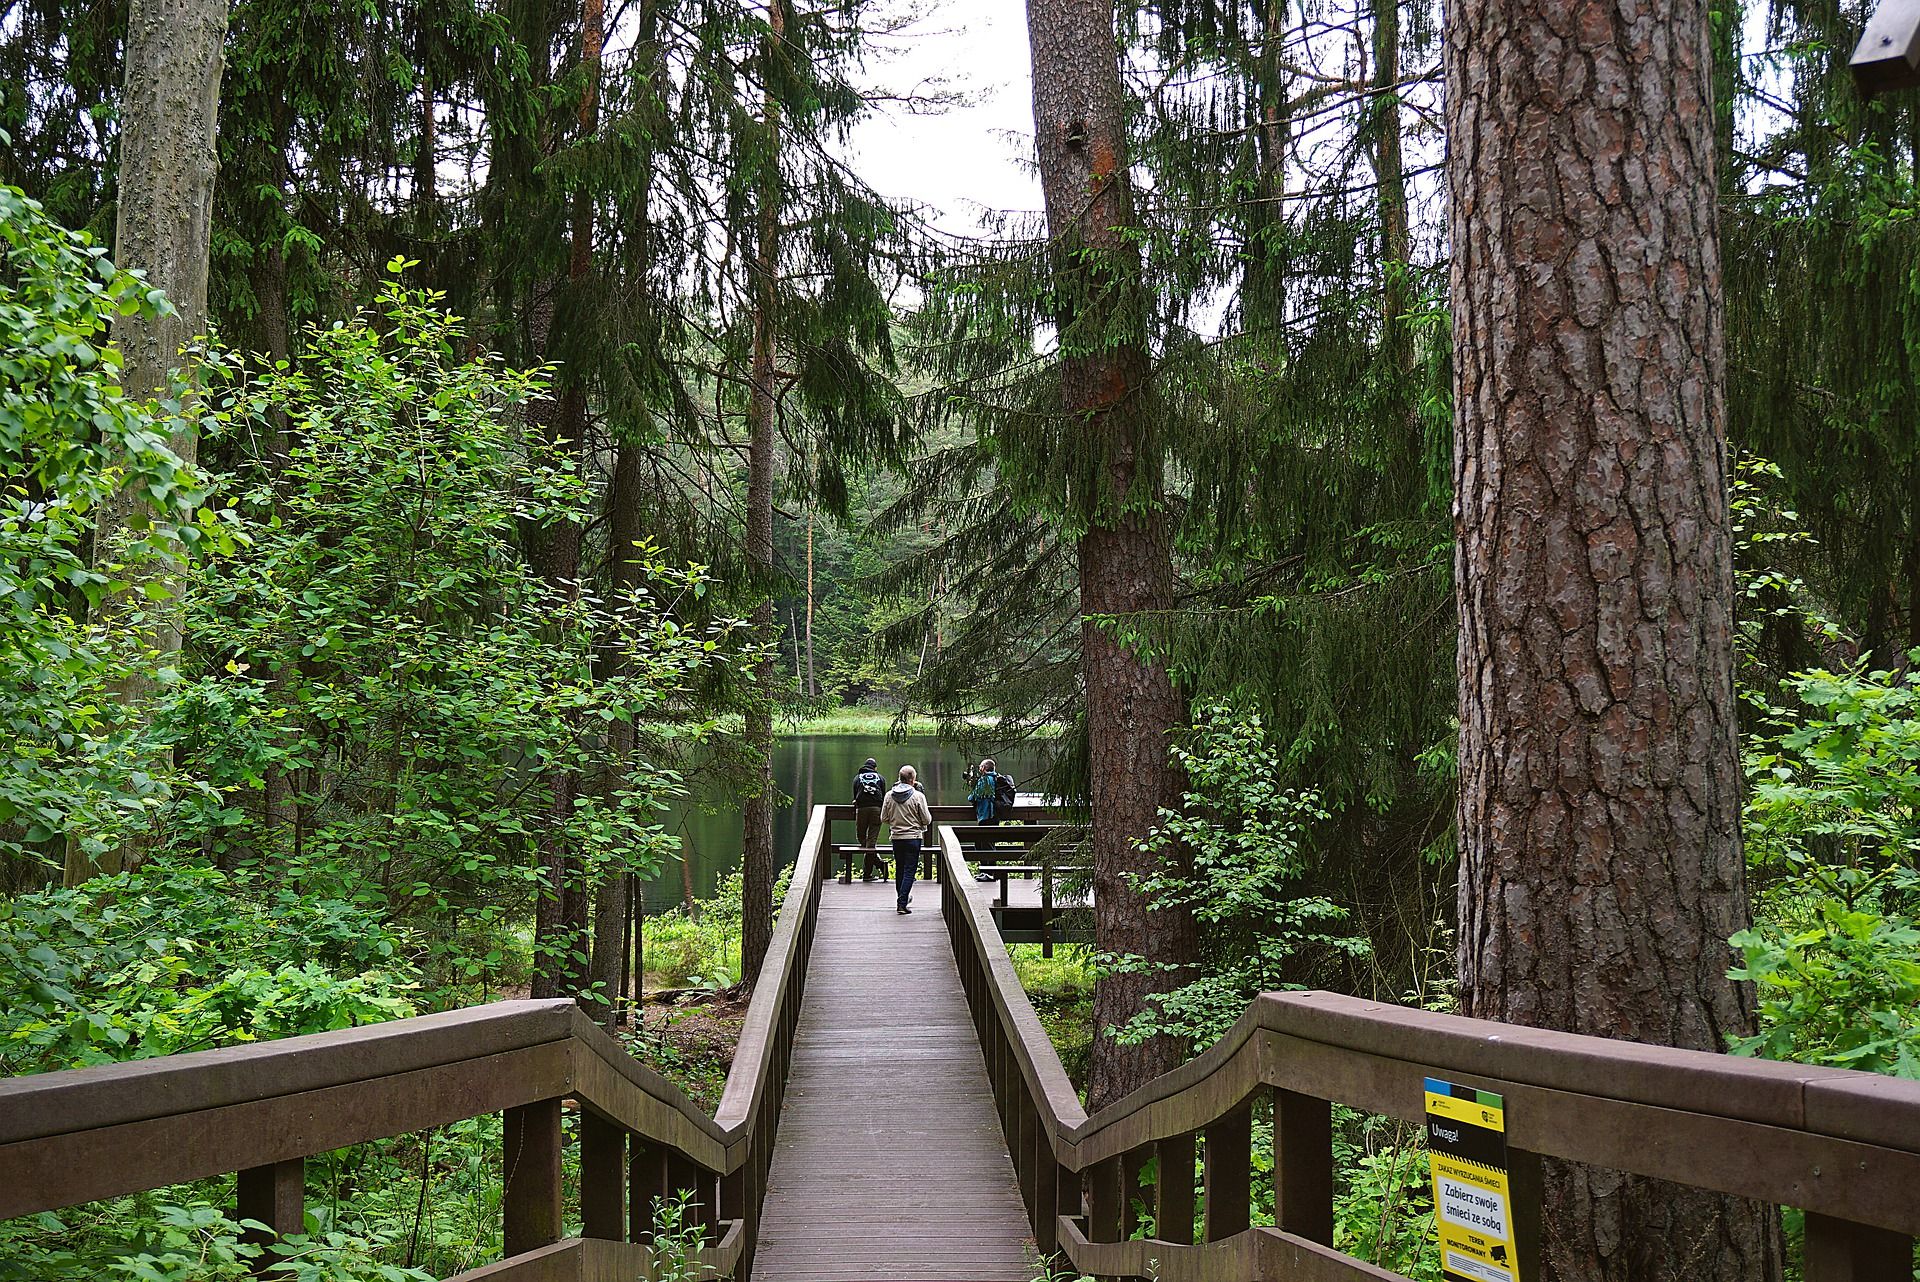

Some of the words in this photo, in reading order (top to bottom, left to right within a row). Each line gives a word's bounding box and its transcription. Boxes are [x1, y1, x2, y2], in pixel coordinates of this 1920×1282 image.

[1432, 1123, 1459, 1143] Uwaga!
[1437, 1163, 1453, 1175] ZAKAZ
[1453, 1168, 1484, 1184] WYRZUCANIA
[1484, 1176, 1500, 1189] ŚMIECI
[1444, 1183, 1474, 1203] Zabierz
[1475, 1196, 1498, 1212] swoje
[1446, 1202, 1470, 1221] śmieci
[1472, 1213, 1481, 1224] ze
[1482, 1216, 1501, 1234] sobą
[1446, 1238, 1486, 1258] MONITOROWANY
[1468, 1235, 1485, 1246] TEREN
